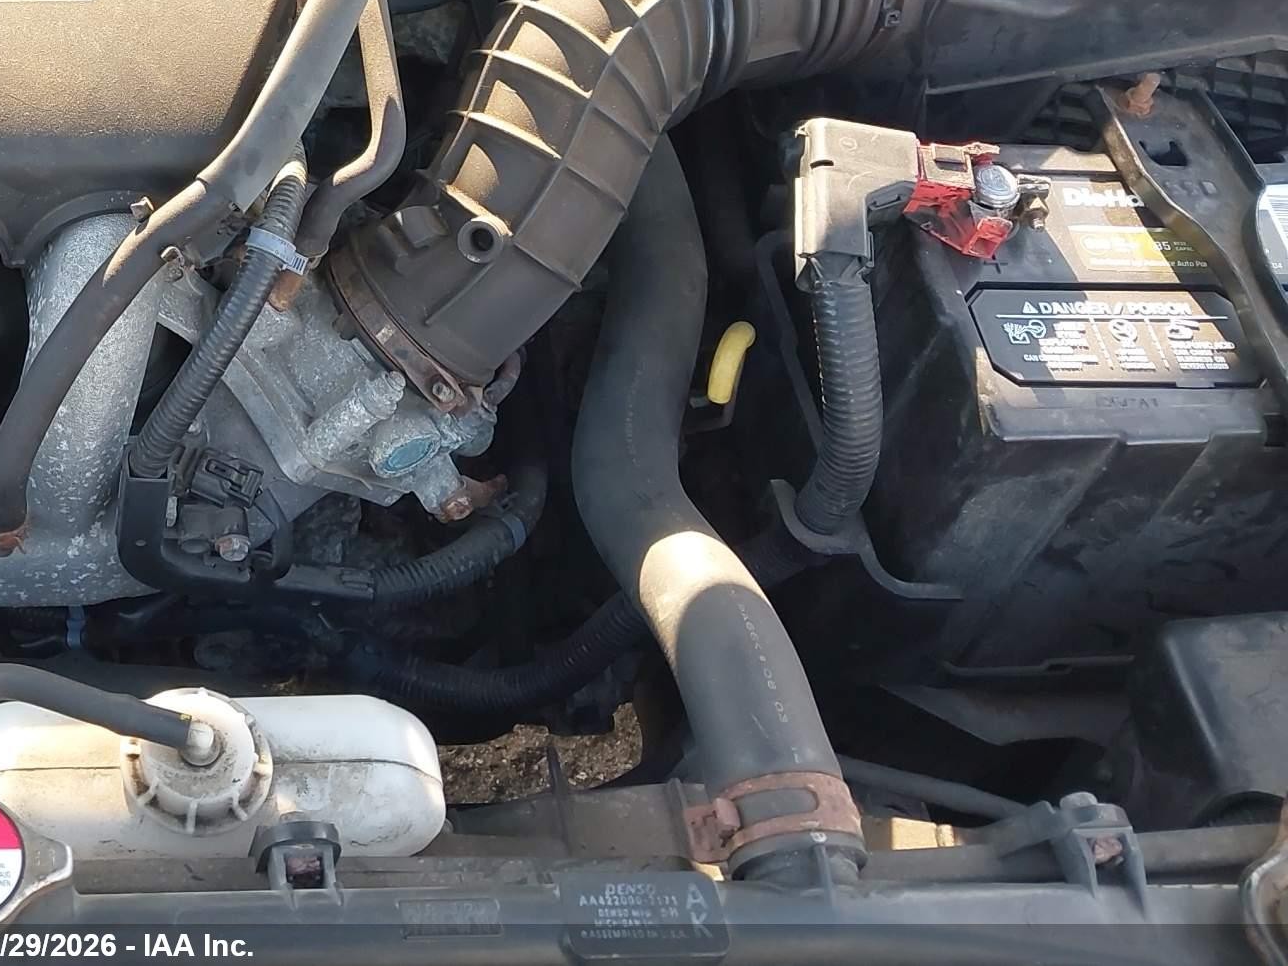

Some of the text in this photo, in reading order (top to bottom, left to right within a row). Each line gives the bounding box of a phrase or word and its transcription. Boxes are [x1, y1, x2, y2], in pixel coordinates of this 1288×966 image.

[1038, 302, 1110, 315] DANGER
[1127, 302, 1192, 315] POISON
[605, 883, 709, 910] DENSO A
[690, 911, 712, 939] K
